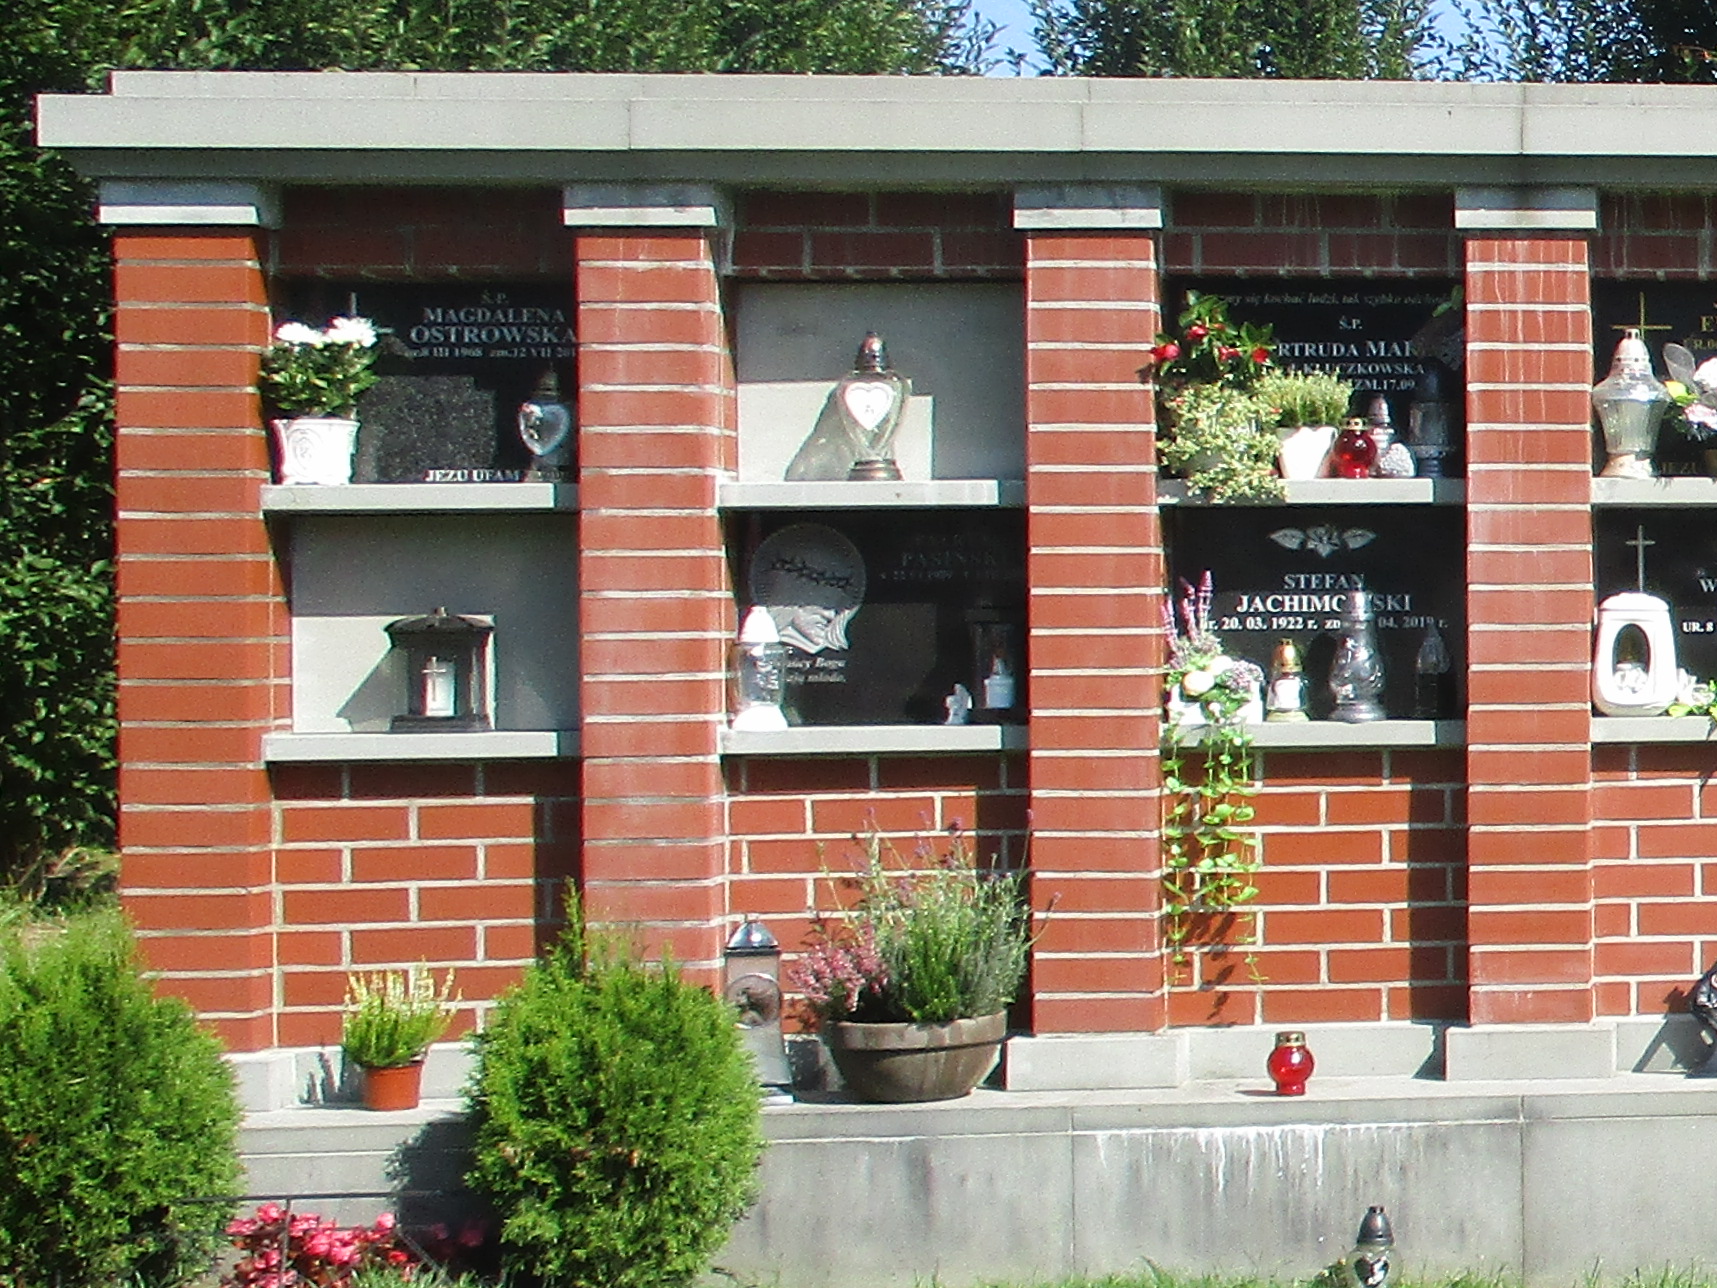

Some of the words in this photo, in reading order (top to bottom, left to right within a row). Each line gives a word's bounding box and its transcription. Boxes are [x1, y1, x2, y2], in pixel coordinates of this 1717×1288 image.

[423, 307, 567, 324] MAGDALENA
[409, 325, 577, 345] OSTROWSKA
[1278, 342, 1359, 358] RTRUDA
[425, 469, 469, 482] JEZU
[1283, 573, 1364, 590] STEFAN
[1221, 617, 1243, 631] 20.
[1245, 617, 1267, 631] 03.
[1271, 617, 1304, 631] 1922
